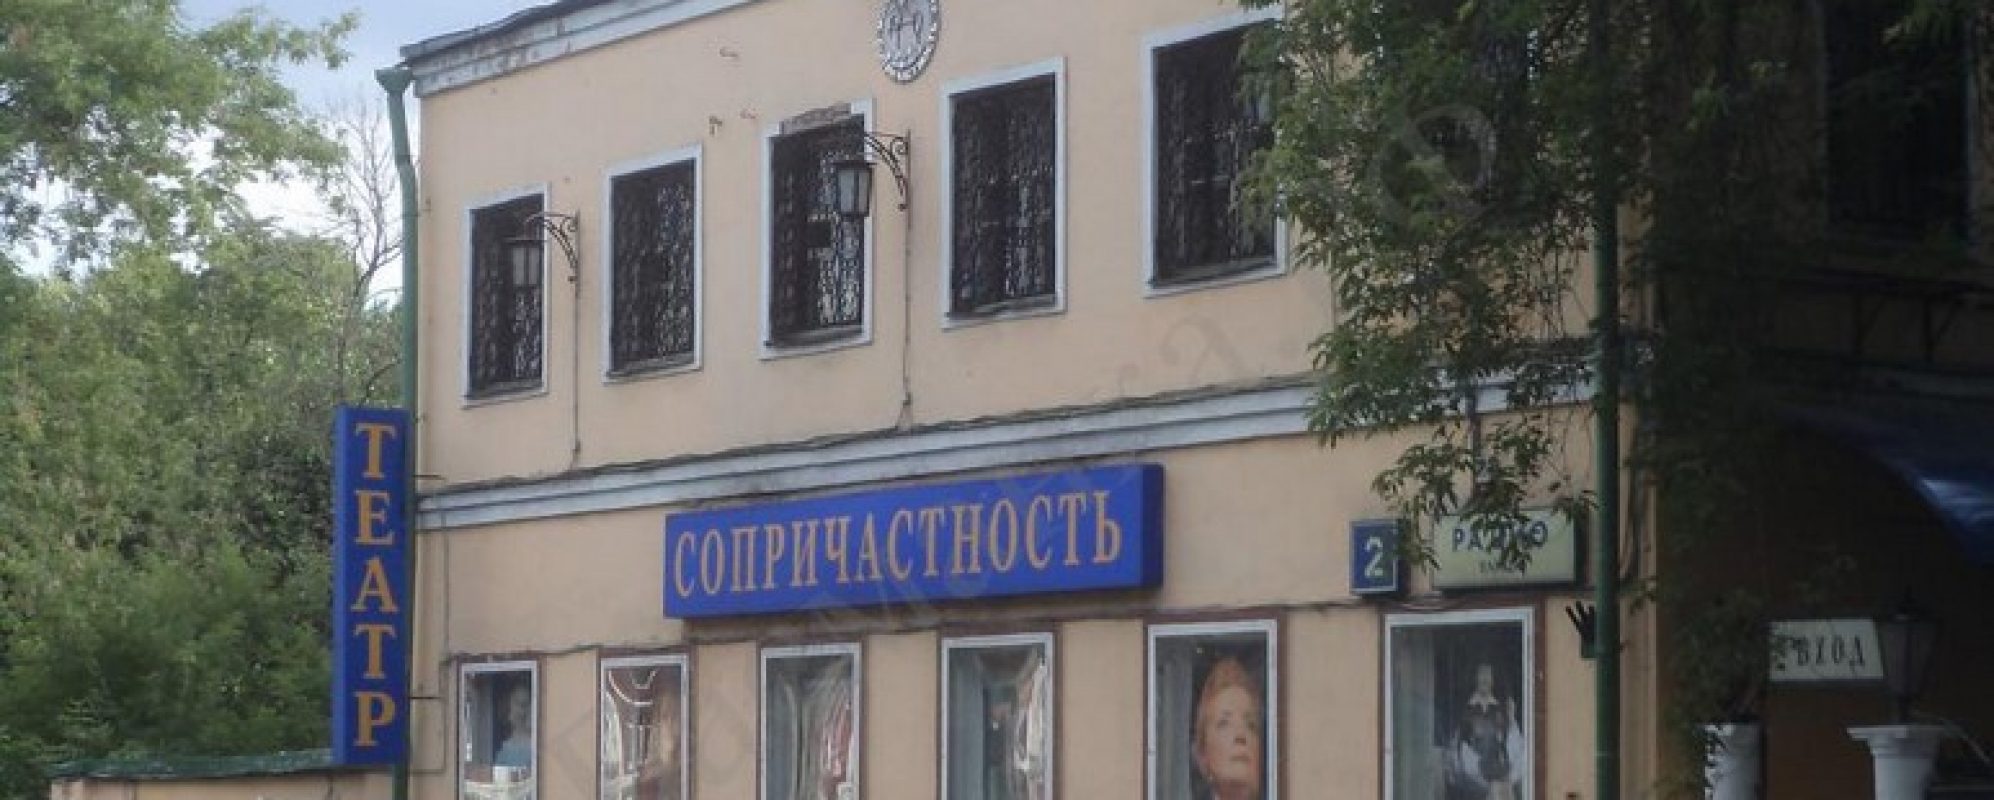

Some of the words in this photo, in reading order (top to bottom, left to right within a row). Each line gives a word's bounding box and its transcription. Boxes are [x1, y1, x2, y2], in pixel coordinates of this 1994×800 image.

[351, 422, 399, 748] ТЕАТР
[674, 489, 1123, 599] СОПРИЧАСТНОСТЬ
[1364, 534, 1386, 580] 2
